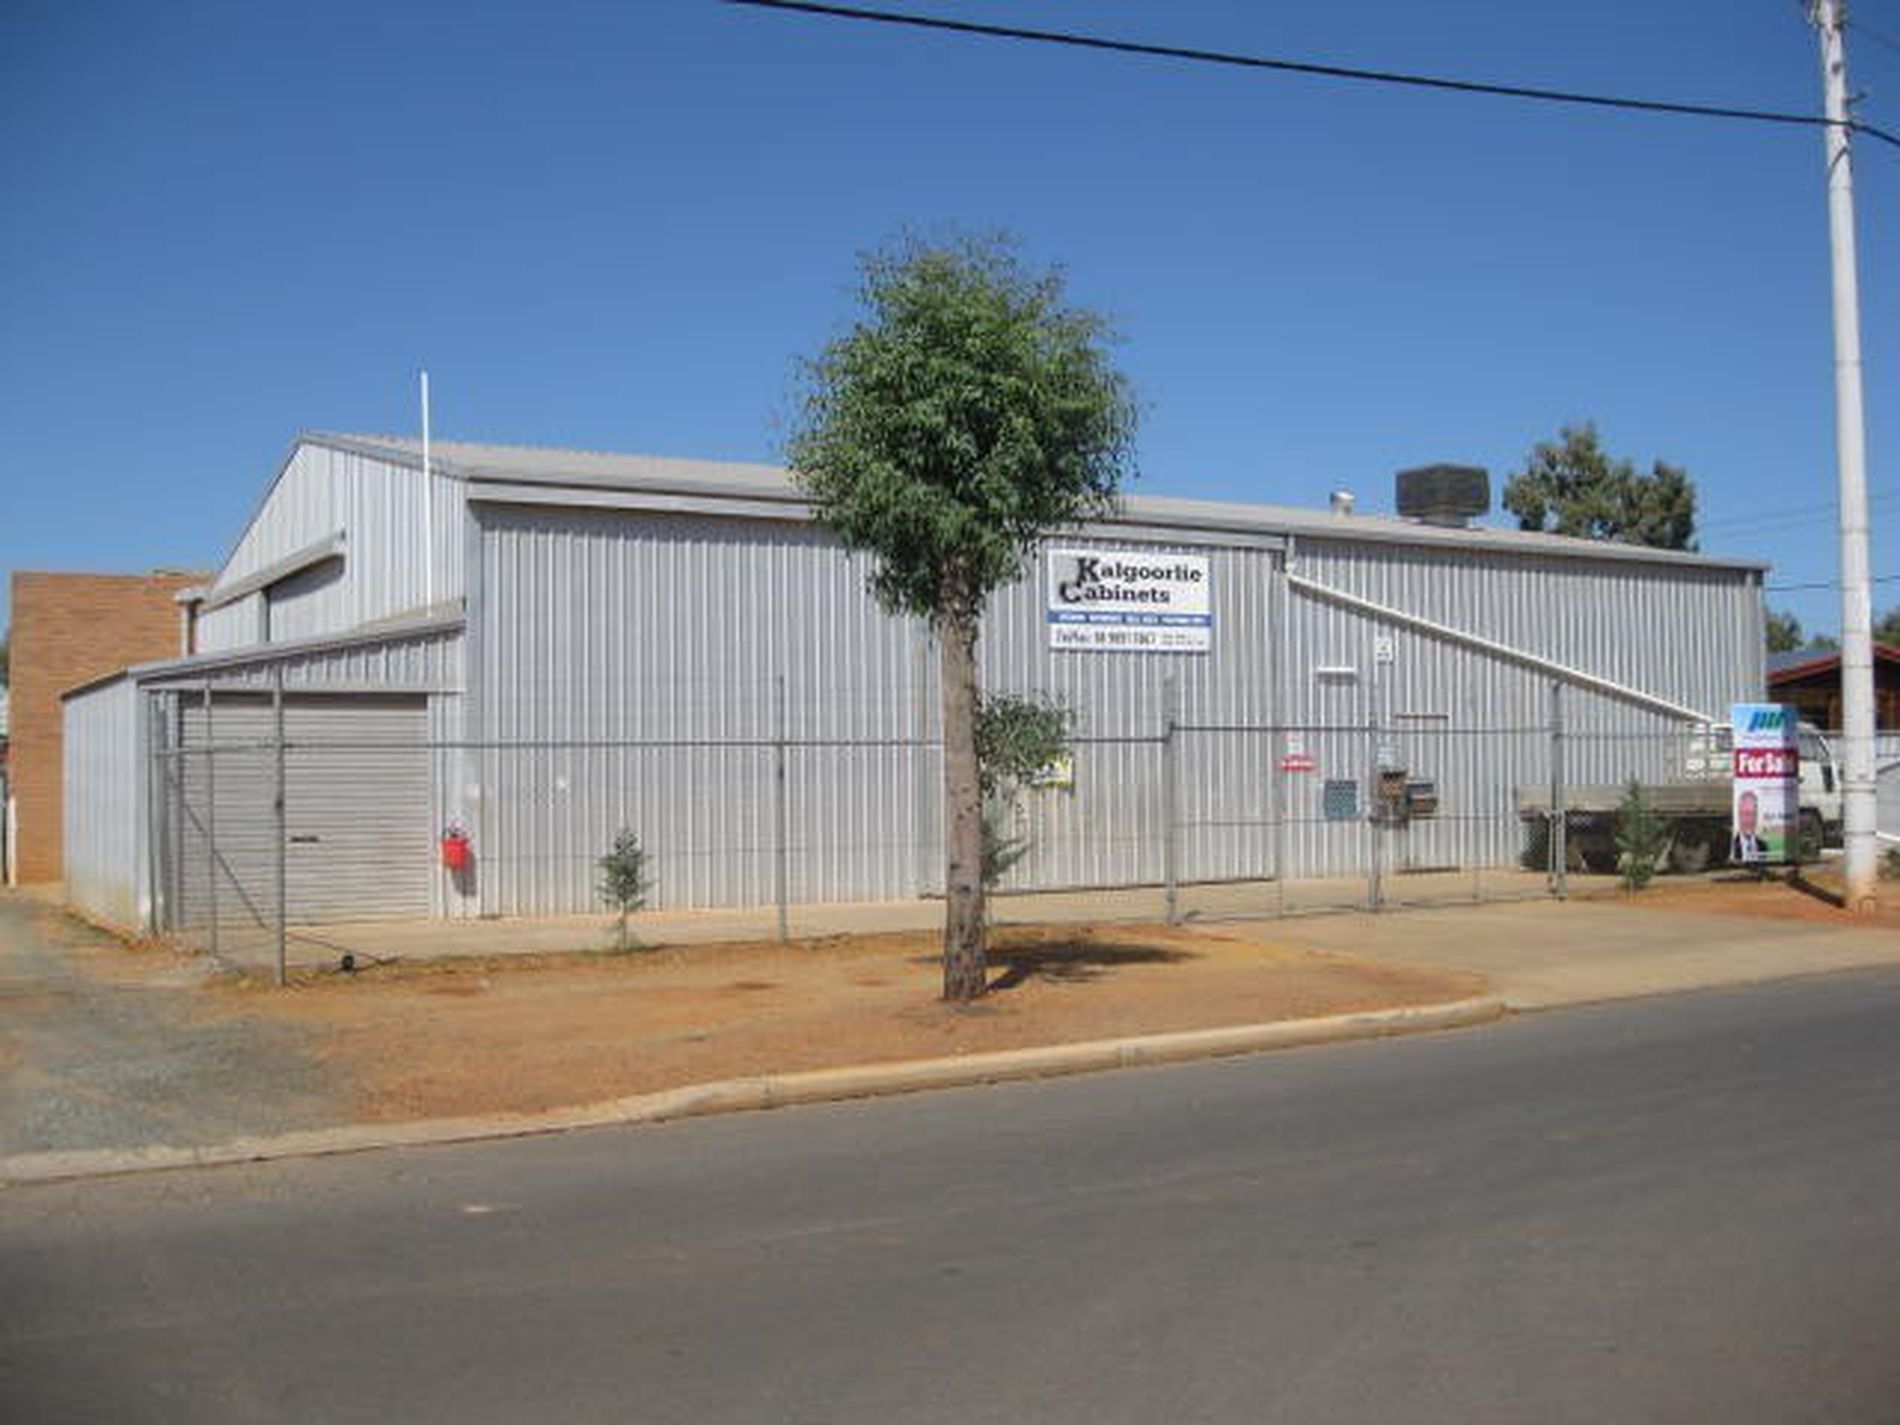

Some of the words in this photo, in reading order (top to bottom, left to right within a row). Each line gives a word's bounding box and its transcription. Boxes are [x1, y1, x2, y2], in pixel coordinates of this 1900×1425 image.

[1077, 557, 1202, 584] Kalgoorlie
[1059, 581, 1170, 604] Cabinets
[1738, 753, 1763, 773] For
